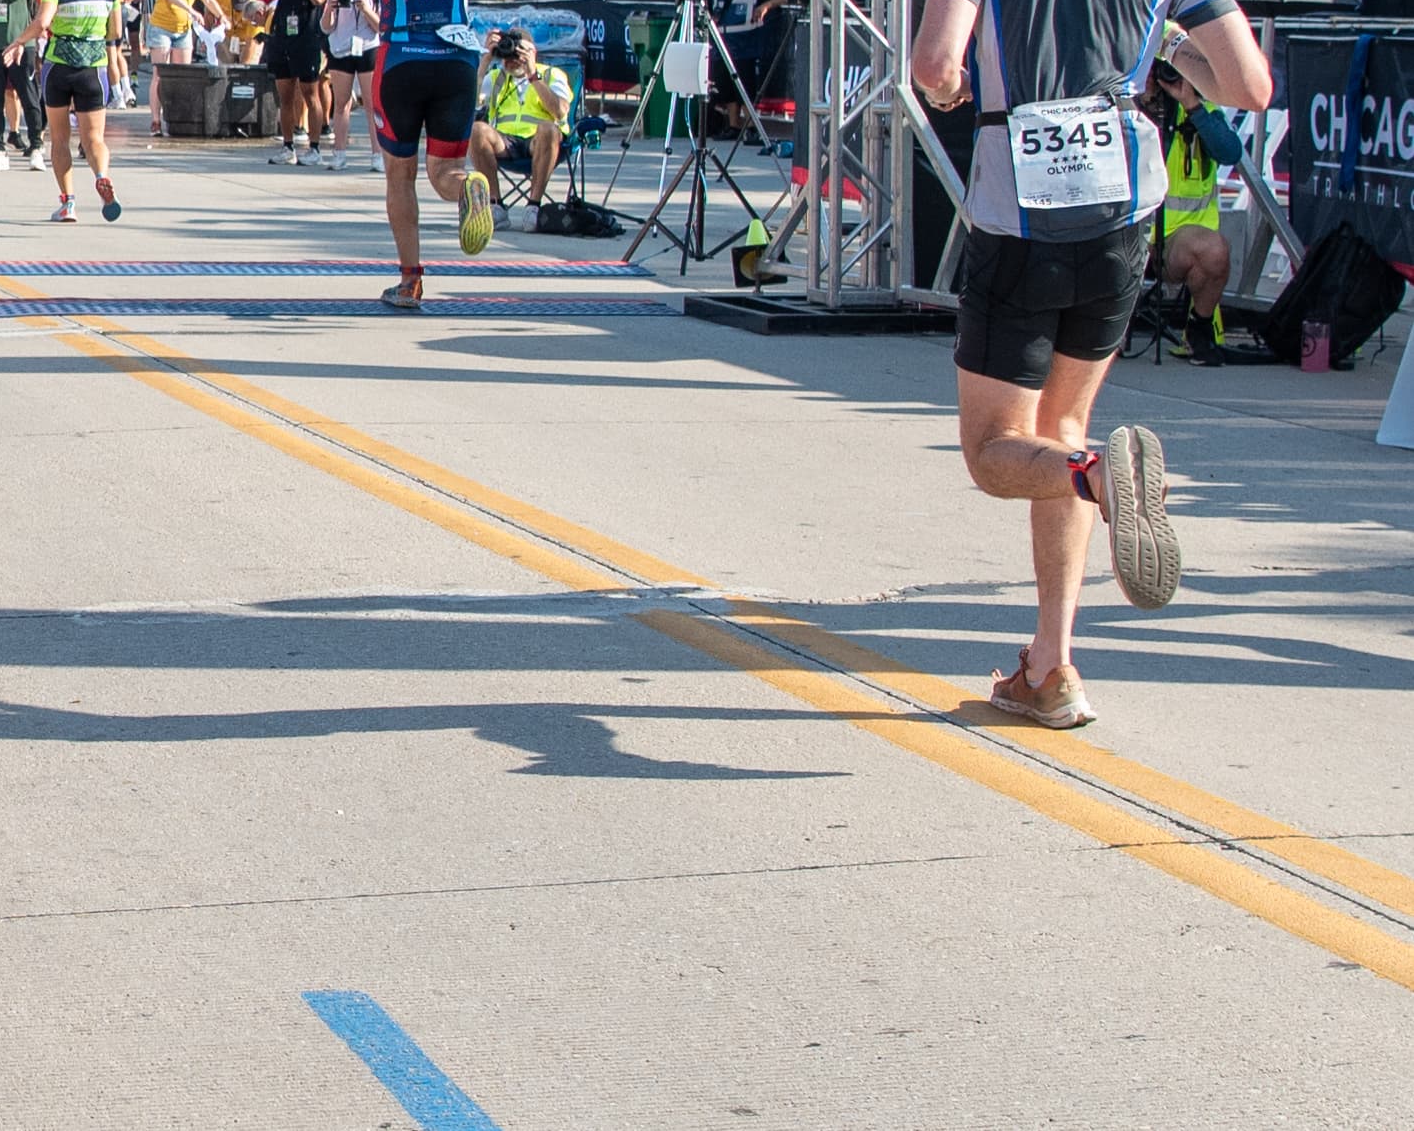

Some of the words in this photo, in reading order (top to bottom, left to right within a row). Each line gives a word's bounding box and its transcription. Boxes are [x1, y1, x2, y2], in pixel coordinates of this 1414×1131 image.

[1041, 106, 1081, 115] CHICAGO
[1021, 121, 1113, 155] 5345
[1047, 163, 1094, 175] OLYMPIC
